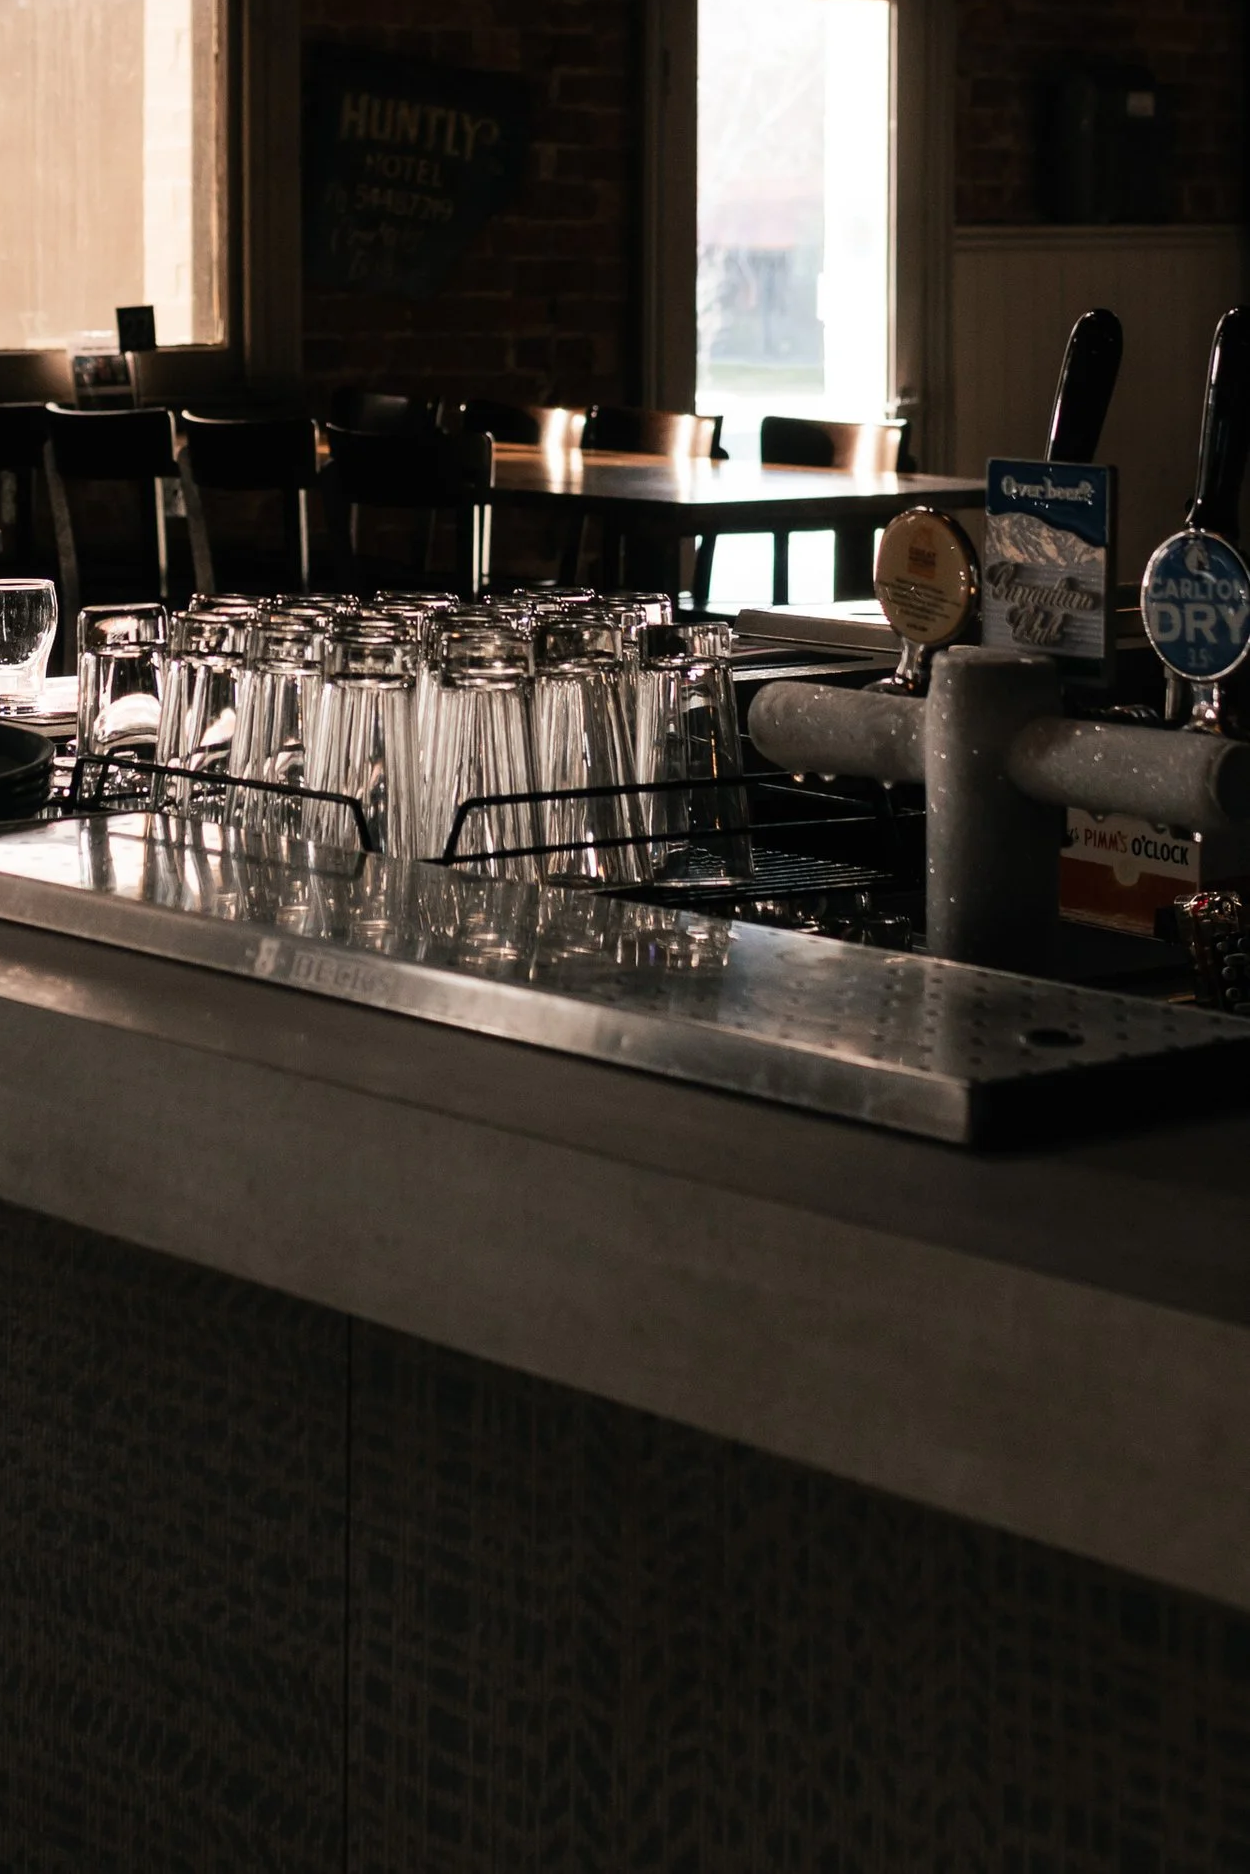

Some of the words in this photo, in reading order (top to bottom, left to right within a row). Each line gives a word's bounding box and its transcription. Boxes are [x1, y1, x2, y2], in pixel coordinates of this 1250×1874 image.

[339, 91, 477, 163] HUNTLY
[365, 153, 444, 188] HOTEL
[1151, 577, 1249, 602] CARLTON
[1151, 601, 1250, 644] DRY
[1084, 829, 1128, 853] PIMM'S
[1132, 835, 1189, 865] O'CLOCK
